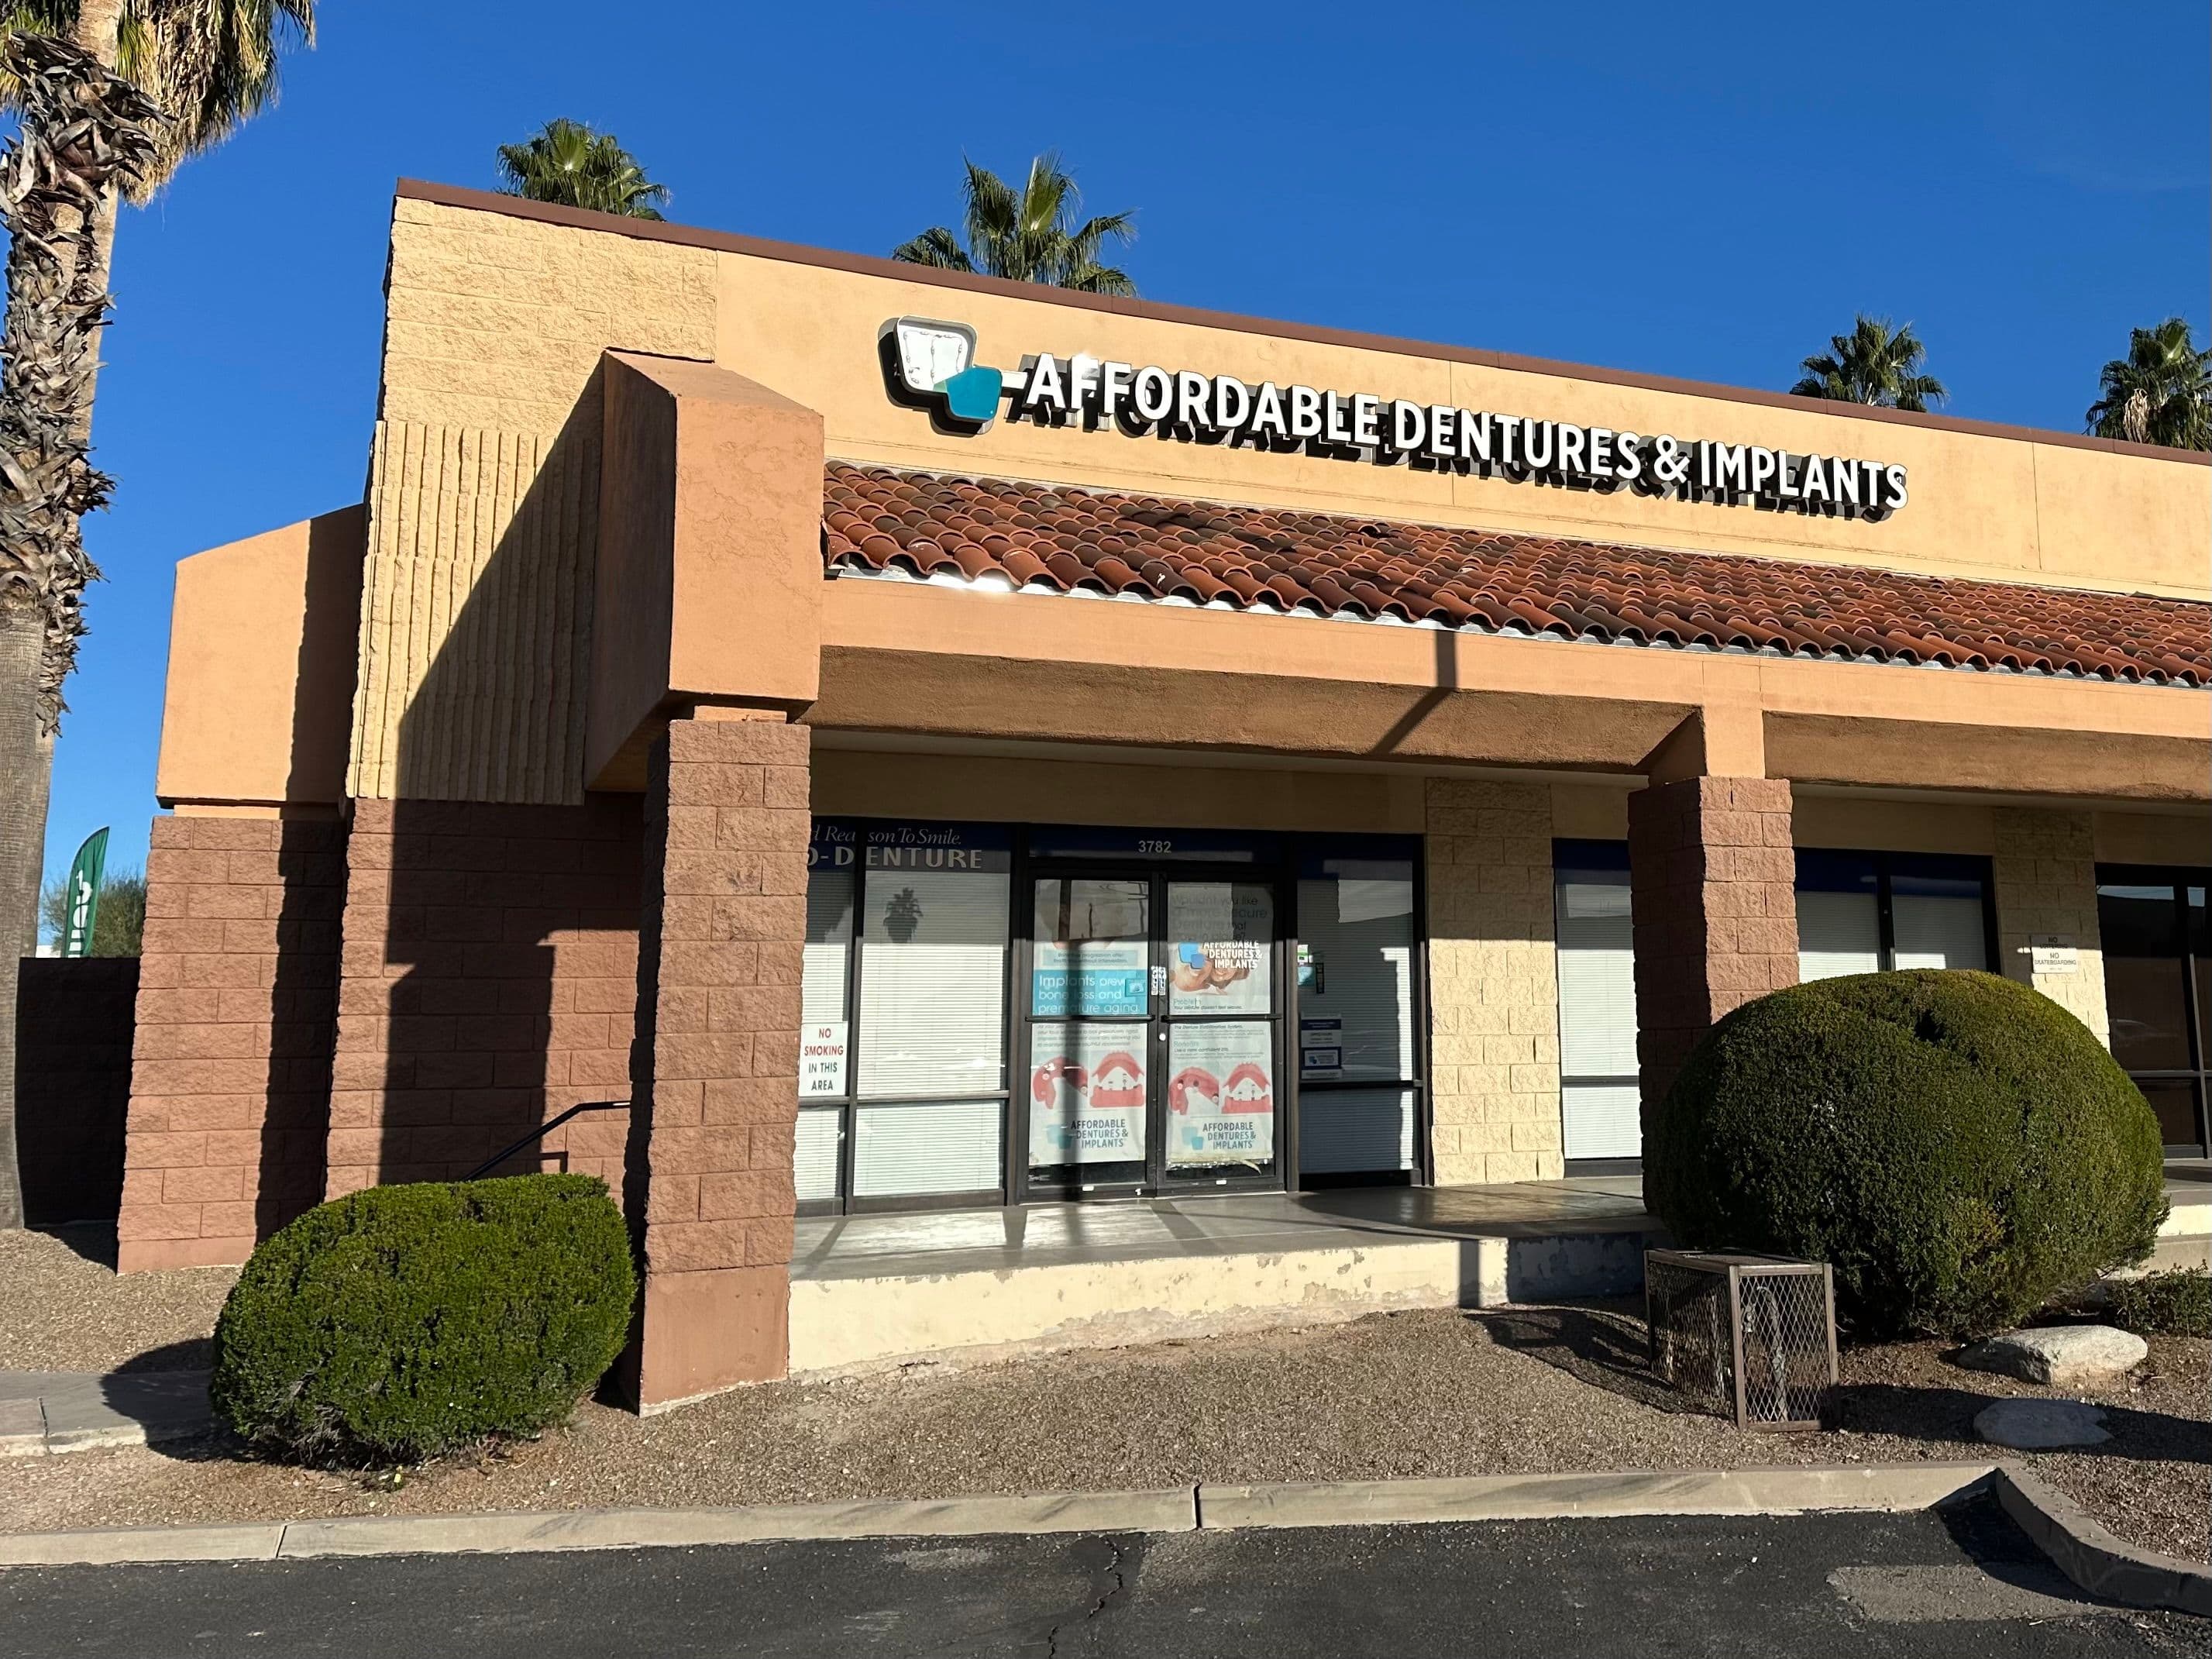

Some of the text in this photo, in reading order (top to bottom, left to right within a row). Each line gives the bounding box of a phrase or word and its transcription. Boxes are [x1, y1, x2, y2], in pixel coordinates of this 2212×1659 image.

[1027, 353, 1908, 511] AFFORDABLE DENTURES & IMPLANTS
[899, 828, 916, 844] To
[917, 828, 962, 845] Smile.
[1138, 840, 1171, 853] 3782
[1203, 941, 1260, 949] AFFORDABLE
[1209, 949, 1263, 959] DENTURES &
[1214, 959, 1258, 969] IMPLANTS
[1039, 974, 1096, 989] Implants
[1039, 990, 1069, 1000] bone
[1099, 988, 1122, 1000] and
[818, 1027, 831, 1038] NO
[804, 1045, 844, 1056] SMOKING
[808, 1062, 838, 1073] IN THIS
[810, 1079, 834, 1091] AREA
[1071, 1118, 1126, 1130] AFFORDABLE
[1202, 1121, 1254, 1132] AFFORDABLE
[1076, 1128, 1129, 1139] DENTURES &
[1208, 1131, 1257, 1141] DENTURES &
[1081, 1138, 1124, 1149] IMPLANTS
[1213, 1140, 1253, 1150] IMPLANTS
